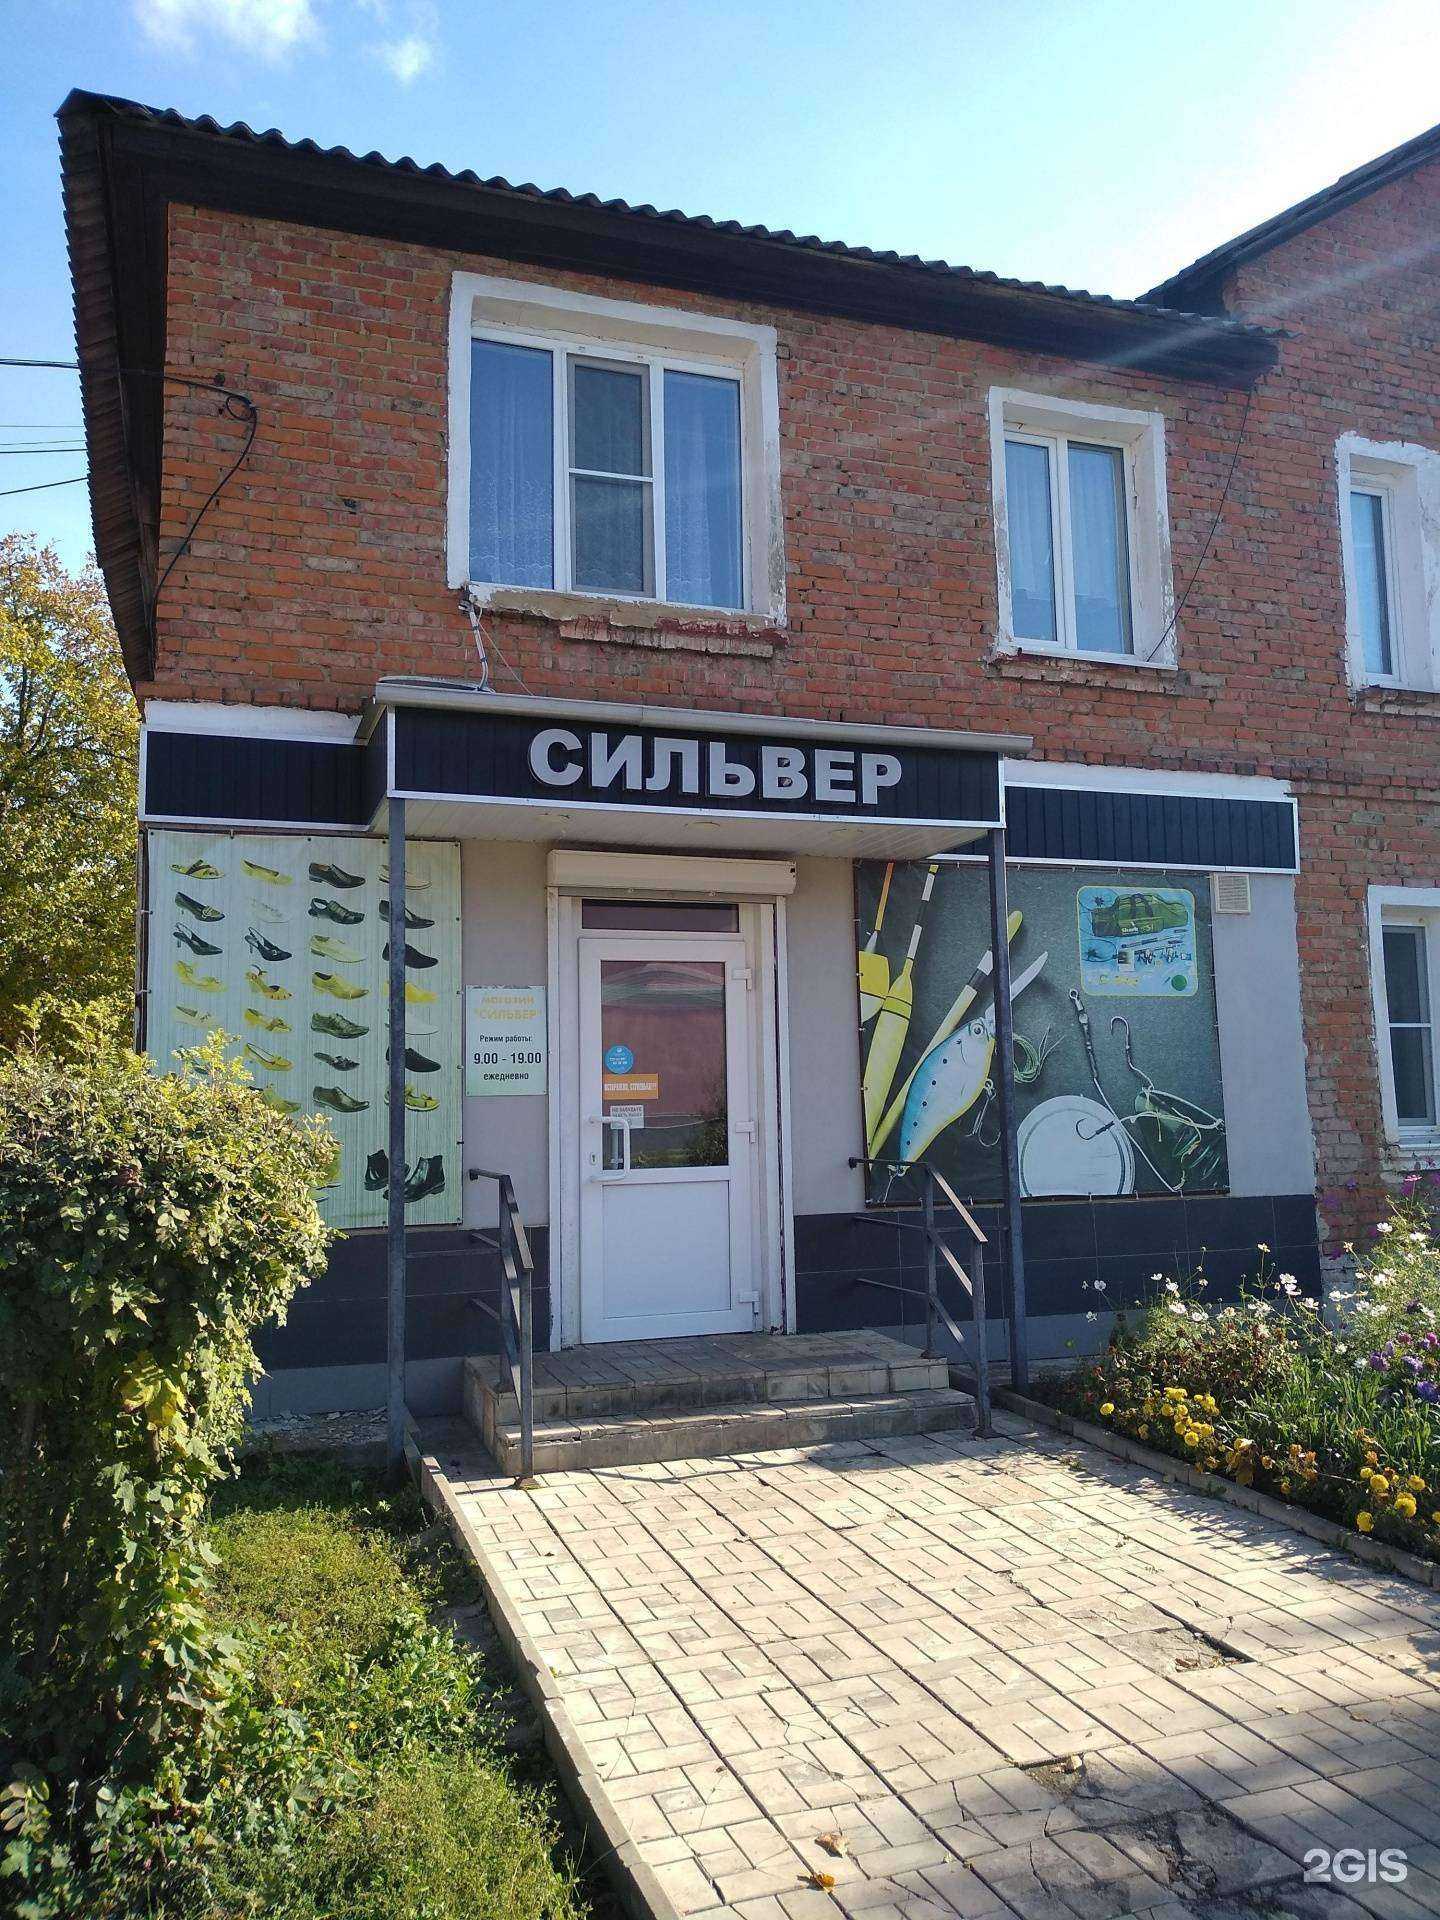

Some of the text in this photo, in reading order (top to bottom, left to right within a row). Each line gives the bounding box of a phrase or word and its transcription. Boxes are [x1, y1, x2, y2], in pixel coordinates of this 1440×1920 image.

[527, 727, 903, 805] СИЛЬВЕР
[479, 1034, 504, 1043] Режим
[474, 1052, 499, 1065] 9.00
[510, 1052, 542, 1064] 19.00
[483, 1072, 529, 1082] ежедневно
